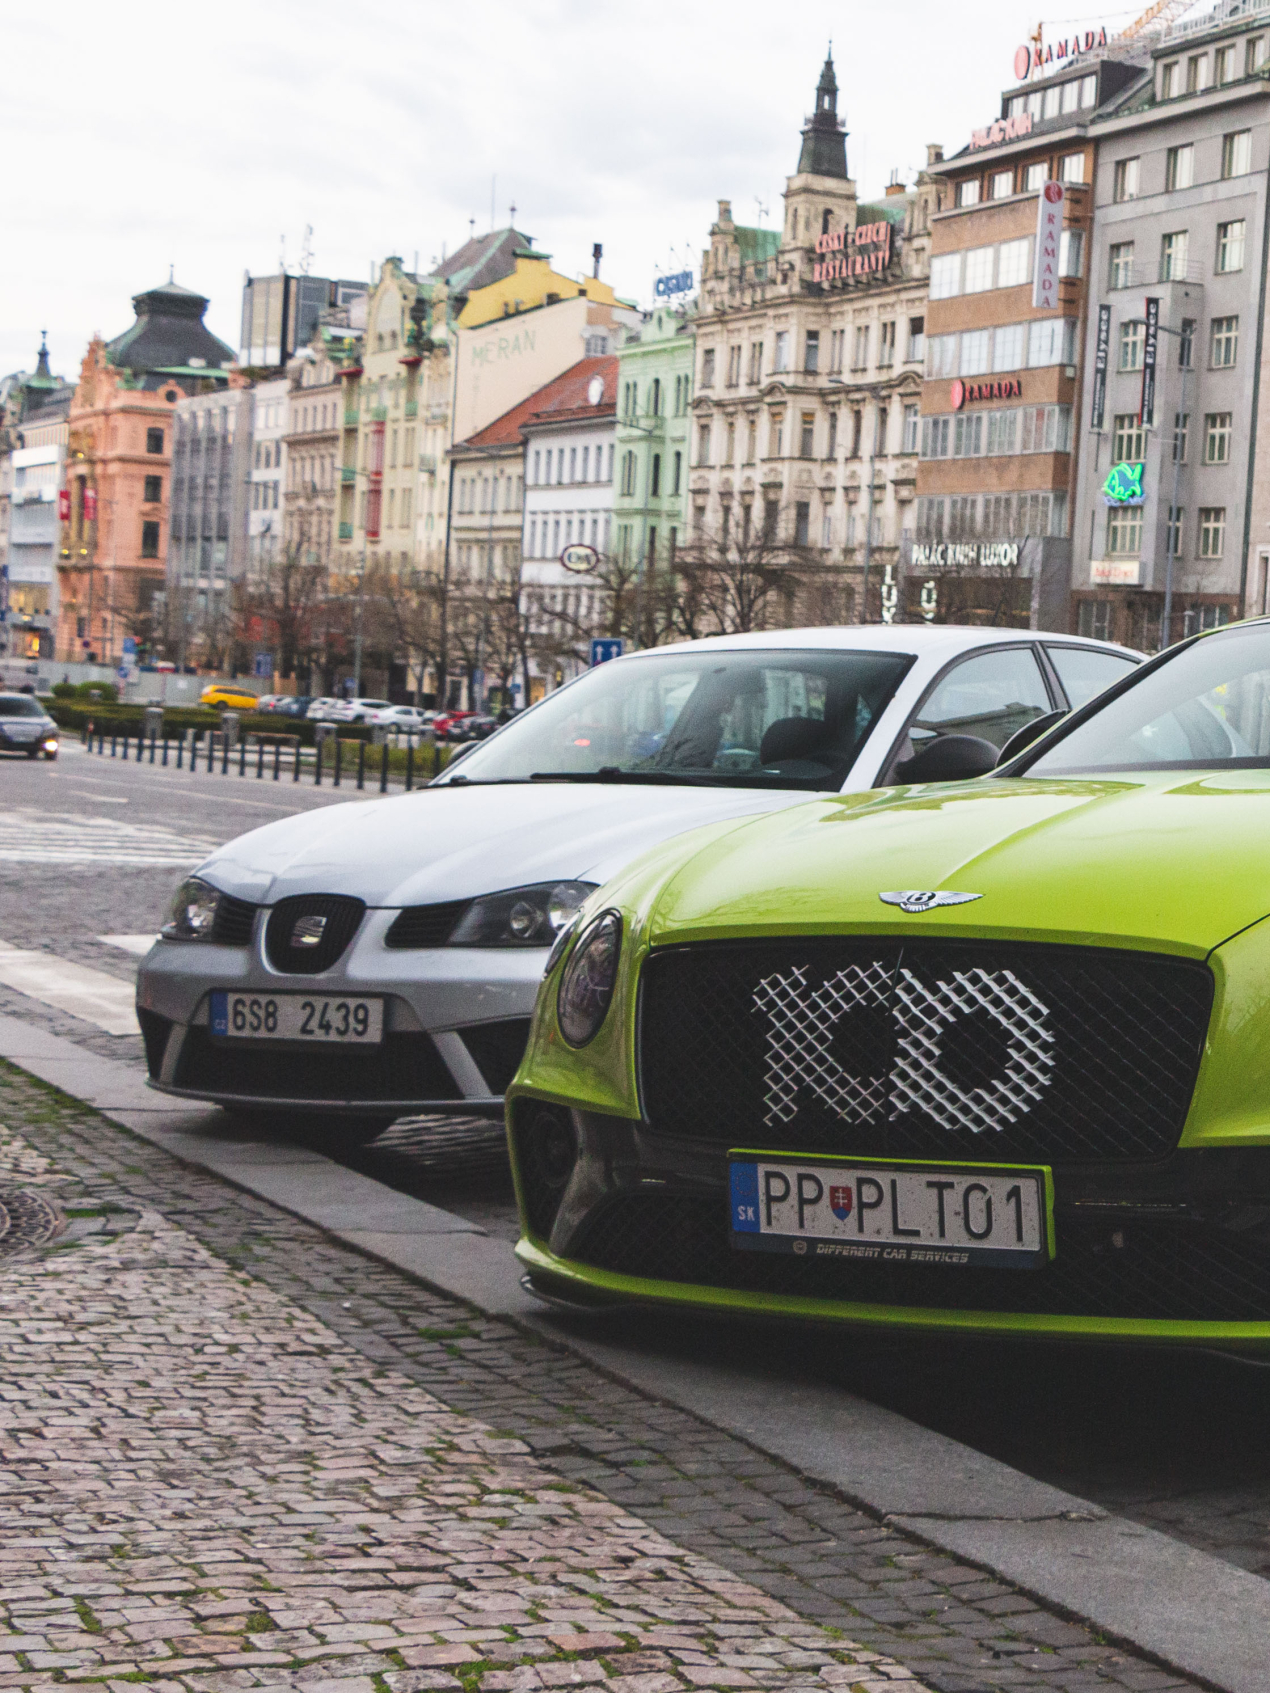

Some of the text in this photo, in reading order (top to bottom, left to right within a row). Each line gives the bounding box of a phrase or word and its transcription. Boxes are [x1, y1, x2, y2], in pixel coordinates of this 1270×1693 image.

[1033, 26, 1107, 66] RAMADA
[814, 252, 885, 283] RESTAURANT
[1041, 213, 1056, 308] RAMADA
[472, 329, 537, 367] MERAN
[1096, 309, 1108, 369] Elysee
[1146, 303, 1157, 364] Elysee
[965, 379, 1023, 402] RAMADA
[980, 542, 1019, 567] LUXOR
[215, 1019, 226, 1030] CZ
[232, 998, 369, 1037] 6S8 2439
[737, 1205, 756, 1222] SK
[764, 1171, 1024, 1242] PP PLT01
[816, 1244, 970, 1263] DIFFERENT CAR SERVICES
